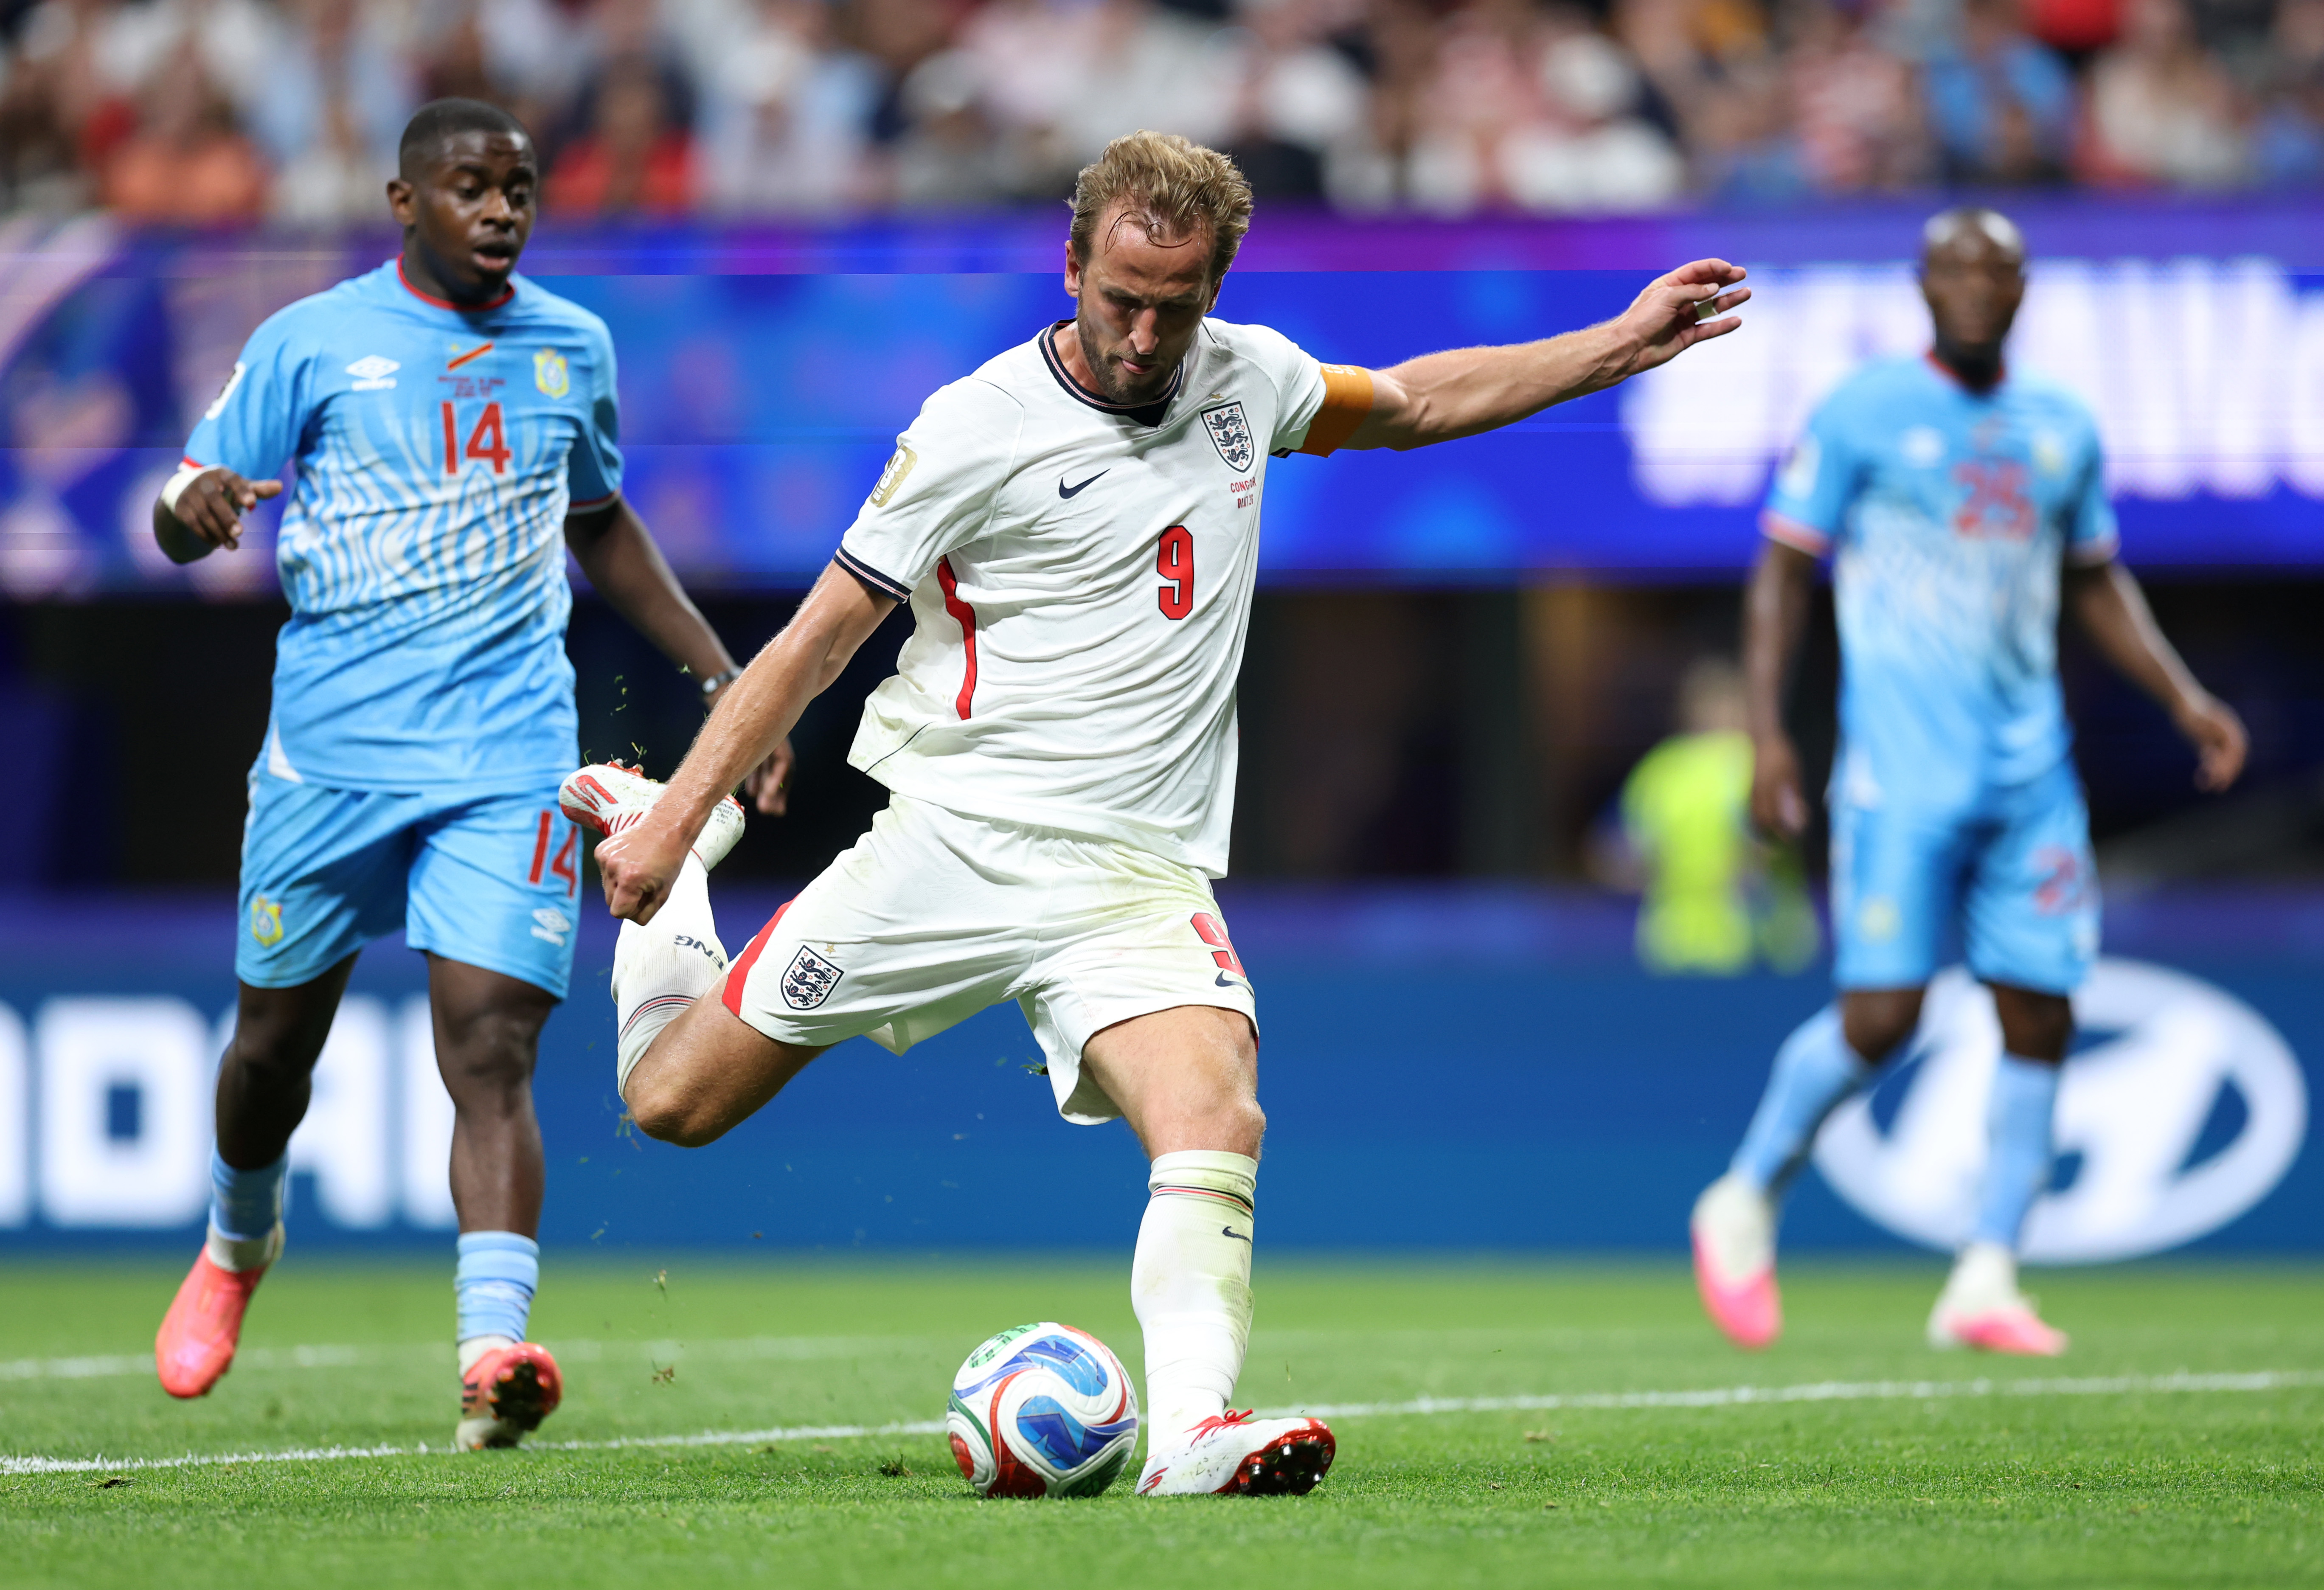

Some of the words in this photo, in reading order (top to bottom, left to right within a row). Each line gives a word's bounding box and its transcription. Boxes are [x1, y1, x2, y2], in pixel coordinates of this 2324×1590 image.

[441, 400, 512, 476] 14
[1156, 525, 1194, 620] 9
[528, 811, 576, 898] 14
[674, 935, 724, 971] ENG
[1190, 912, 1246, 978] 9
[0, 994, 459, 1228] DAI
